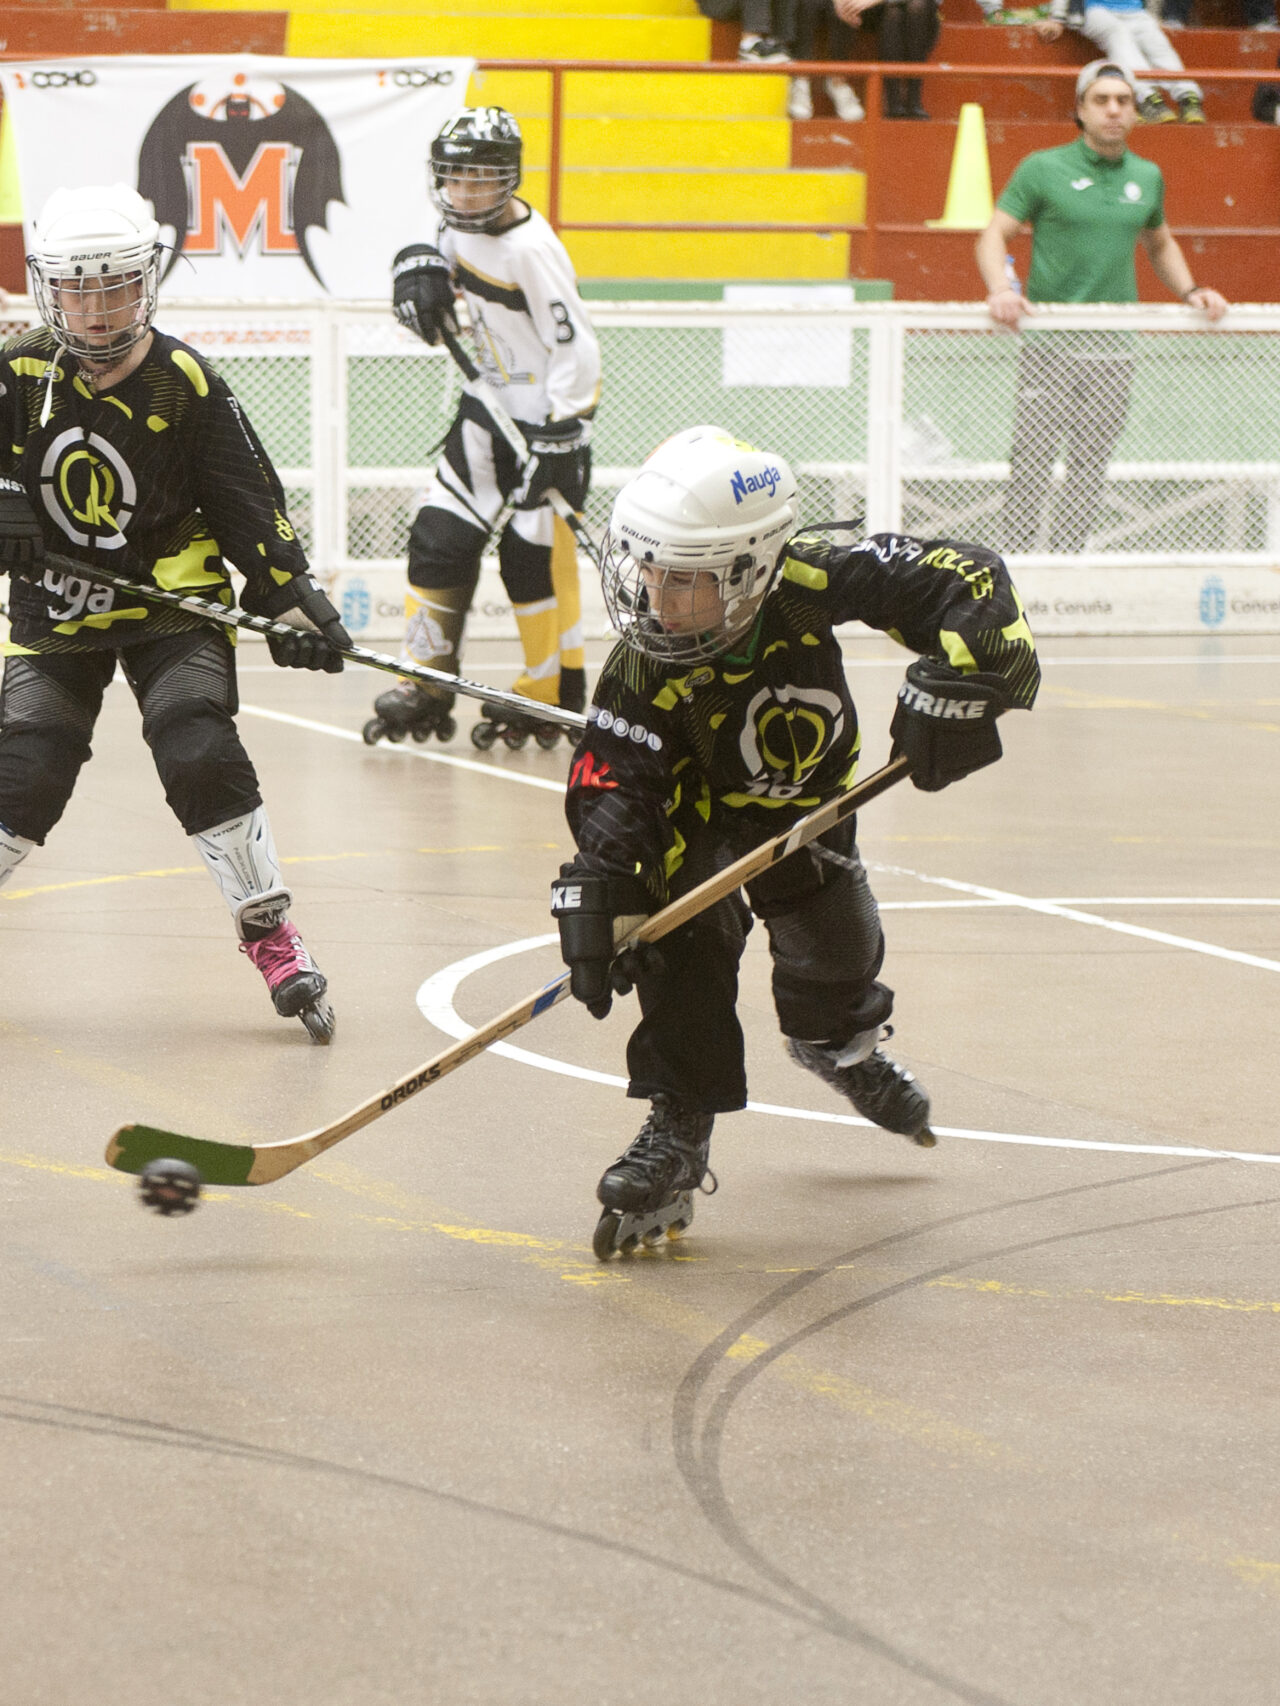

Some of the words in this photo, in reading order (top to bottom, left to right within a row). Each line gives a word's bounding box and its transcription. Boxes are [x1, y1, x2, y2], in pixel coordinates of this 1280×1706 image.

[179, 141, 304, 262] M
[70, 251, 112, 262] BAUER
[729, 465, 782, 506] Nauga
[1230, 597, 1280, 615] Conce
[379, 1062, 442, 1112] OROKS
